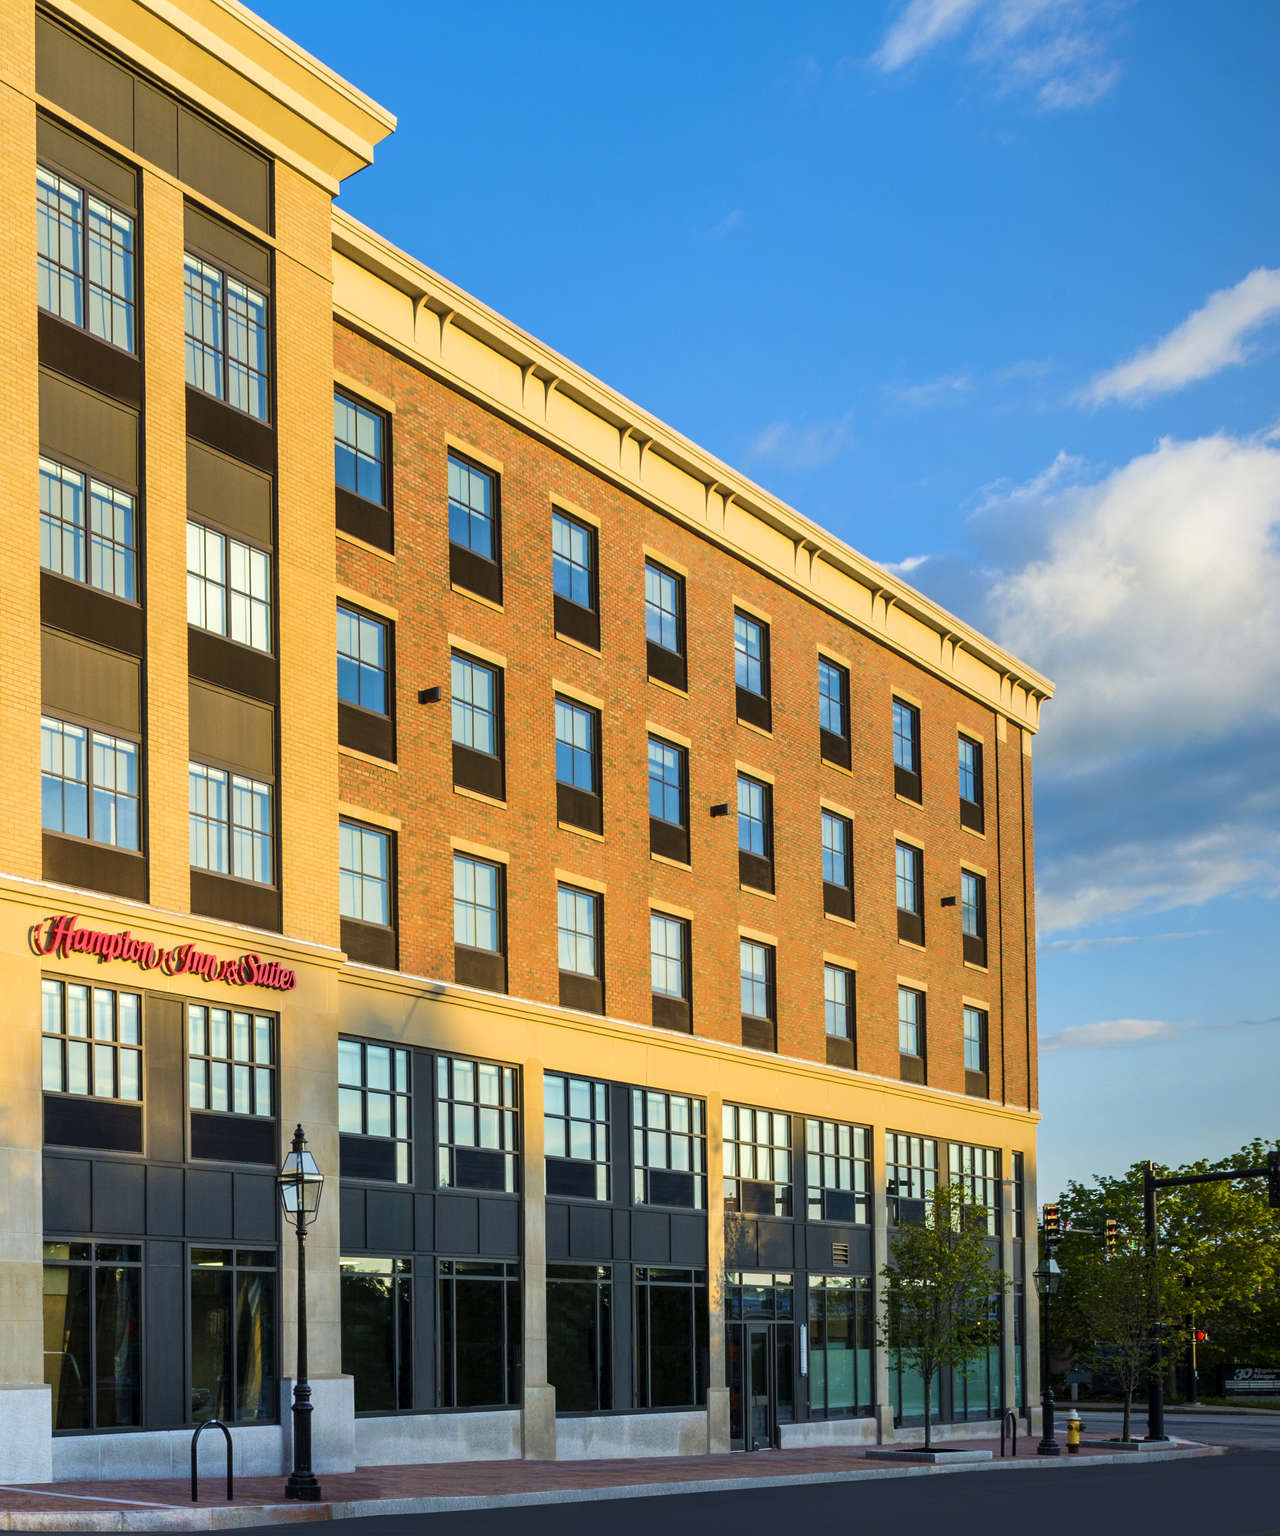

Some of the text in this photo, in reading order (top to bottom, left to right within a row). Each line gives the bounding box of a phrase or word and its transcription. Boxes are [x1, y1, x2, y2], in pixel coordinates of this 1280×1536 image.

[32, 914, 297, 991] Hampton Inn & Suites
